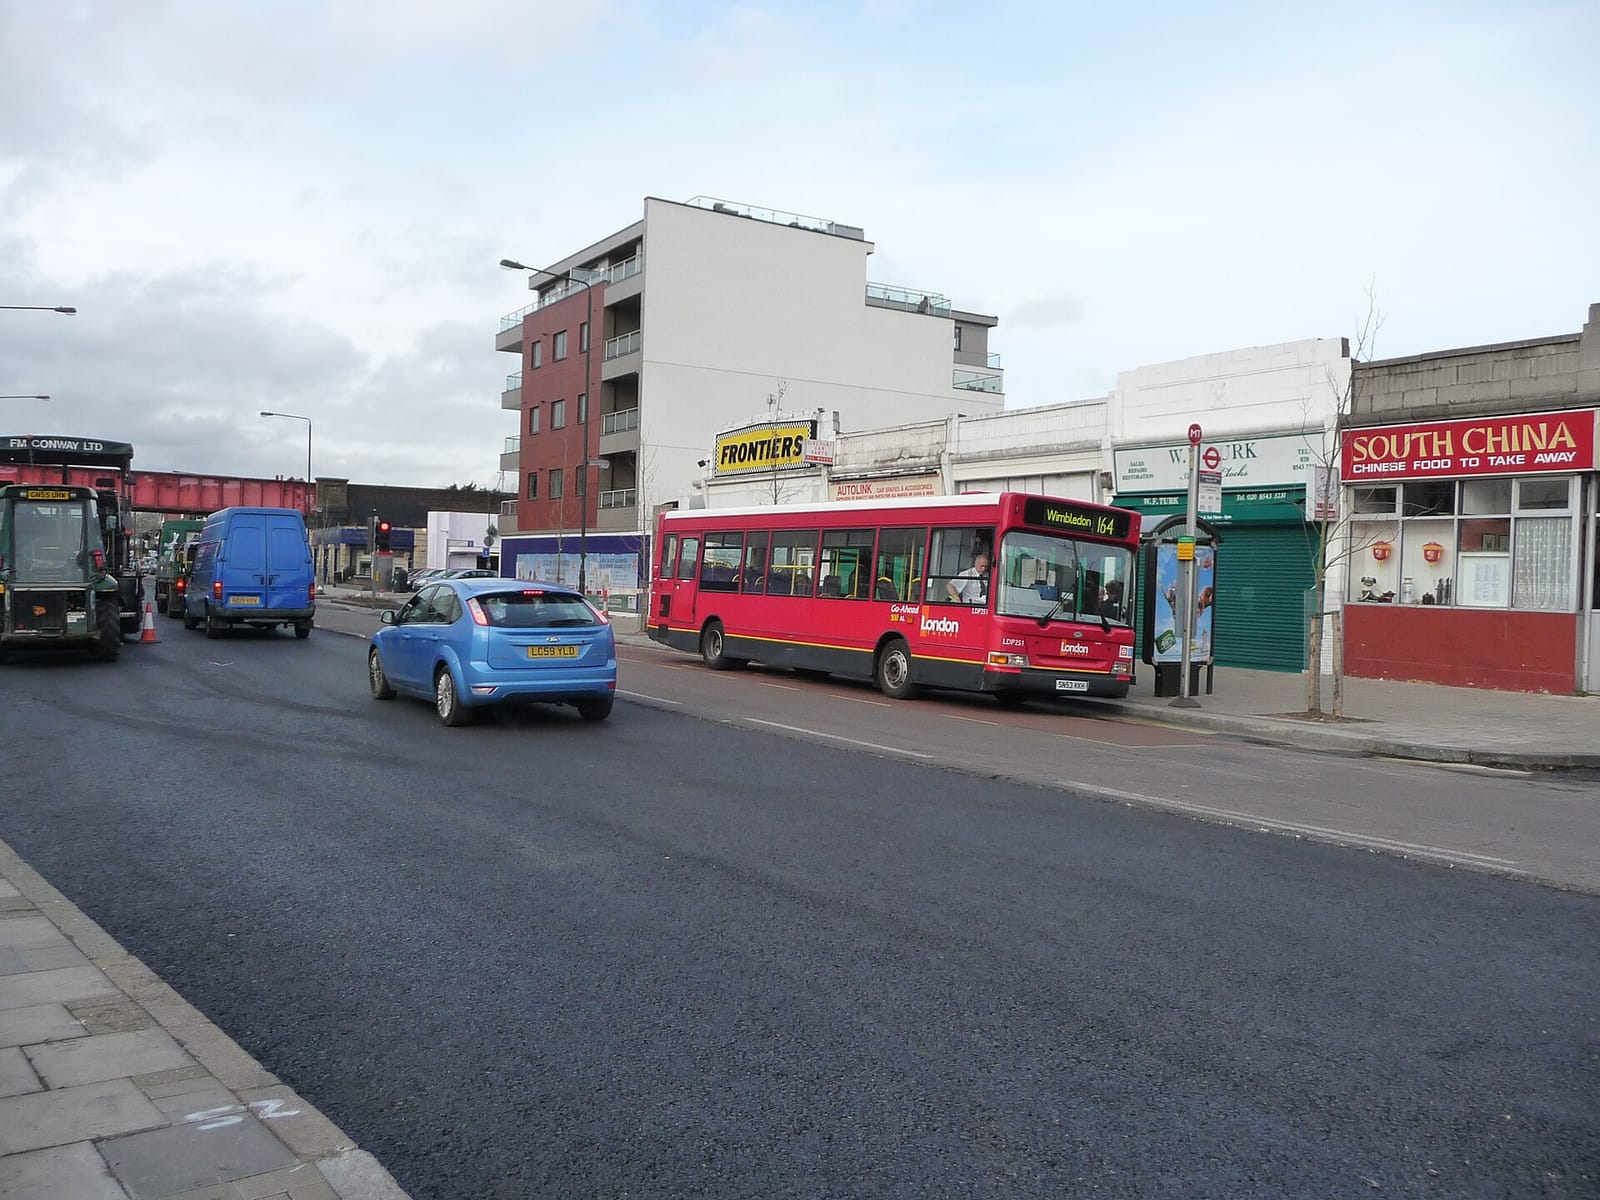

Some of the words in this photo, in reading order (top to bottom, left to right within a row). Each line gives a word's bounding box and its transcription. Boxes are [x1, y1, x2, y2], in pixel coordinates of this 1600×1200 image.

[10, 439, 27, 448] FM
[31, 440, 79, 450] CONWAY
[83, 442, 103, 451] LTD
[1352, 430, 1454, 462] SOUTH
[1462, 421, 1577, 454] CHINA
[720, 435, 804, 465] FRONTIERS
[1352, 461, 1406, 474] CHINESE
[1413, 458, 1451, 470] FOOD
[1460, 457, 1479, 468] TO
[1487, 454, 1525, 466] TAKE
[1534, 451, 1576, 464] AWAY
[837, 484, 873, 496] AUTOLINK
[1047, 508, 1092, 527] Wimbledon
[1096, 516, 1114, 535] 164
[890, 604, 919, 614] Go-Ahead
[920, 615, 959, 633] London
[1002, 637, 1025, 647] LDP251
[1060, 642, 1089, 655] London
[531, 647, 555, 656] LC59
[557, 646, 575, 656] YLD
